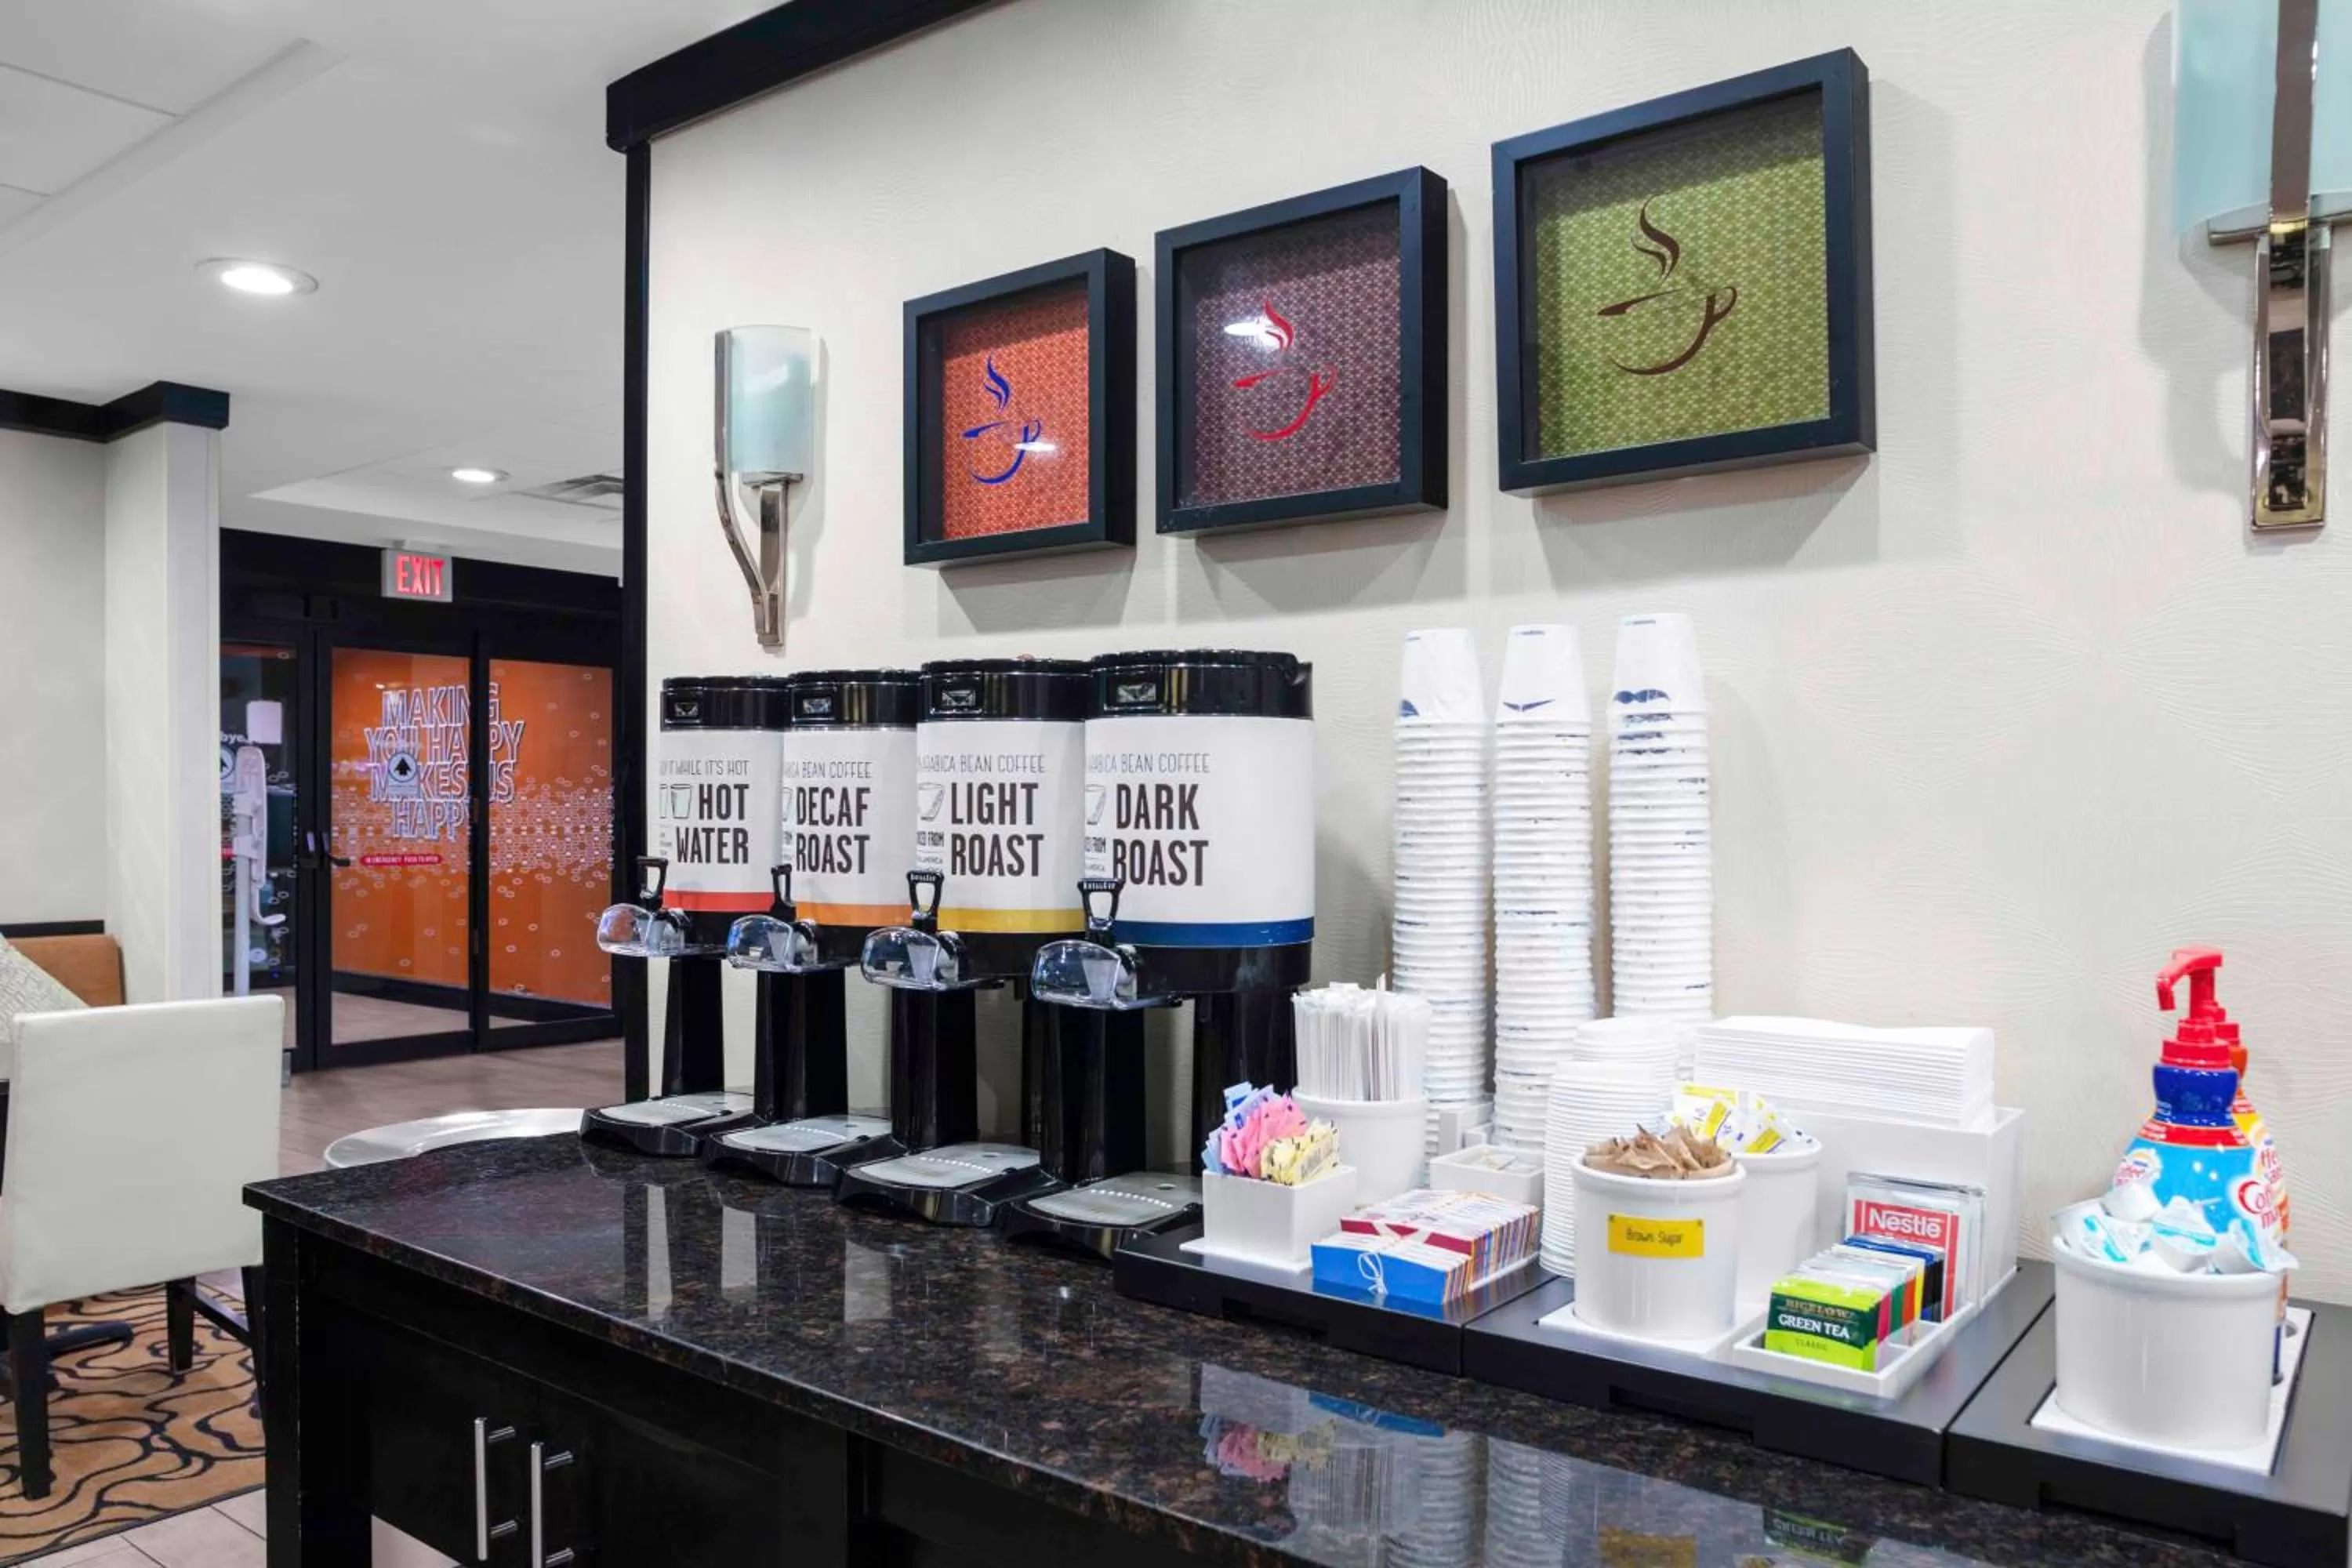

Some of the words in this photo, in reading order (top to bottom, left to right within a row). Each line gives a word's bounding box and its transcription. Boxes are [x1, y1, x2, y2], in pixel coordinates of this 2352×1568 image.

[397, 554, 445, 594] EXIT
[426, 720, 525, 764] HAPY
[706, 759, 724, 775] IT'S
[728, 760, 750, 775] HOT
[802, 760, 826, 778] BEAN
[829, 760, 873, 779] COFFEE
[960, 754, 992, 772] BEAN
[997, 753, 1046, 773] COFFEE
[1121, 753, 1153, 773] BEAN
[1158, 753, 1211, 773] COFFEE
[699, 784, 750, 820] HOT
[797, 786, 871, 826] DECAF
[951, 782, 1038, 826] LIGHT
[1116, 783, 1200, 829] DARK
[676, 827, 749, 864] WATER
[797, 833, 870, 873] ROAST
[951, 833, 1044, 877] ROAST
[1112, 839, 1209, 886] ROAST
[1626, 1228, 1653, 1243] Brown
[1657, 1230, 1685, 1248] Sugar
[1777, 1313, 1821, 1334] GREEN
[1824, 1322, 1850, 1339] TEA
